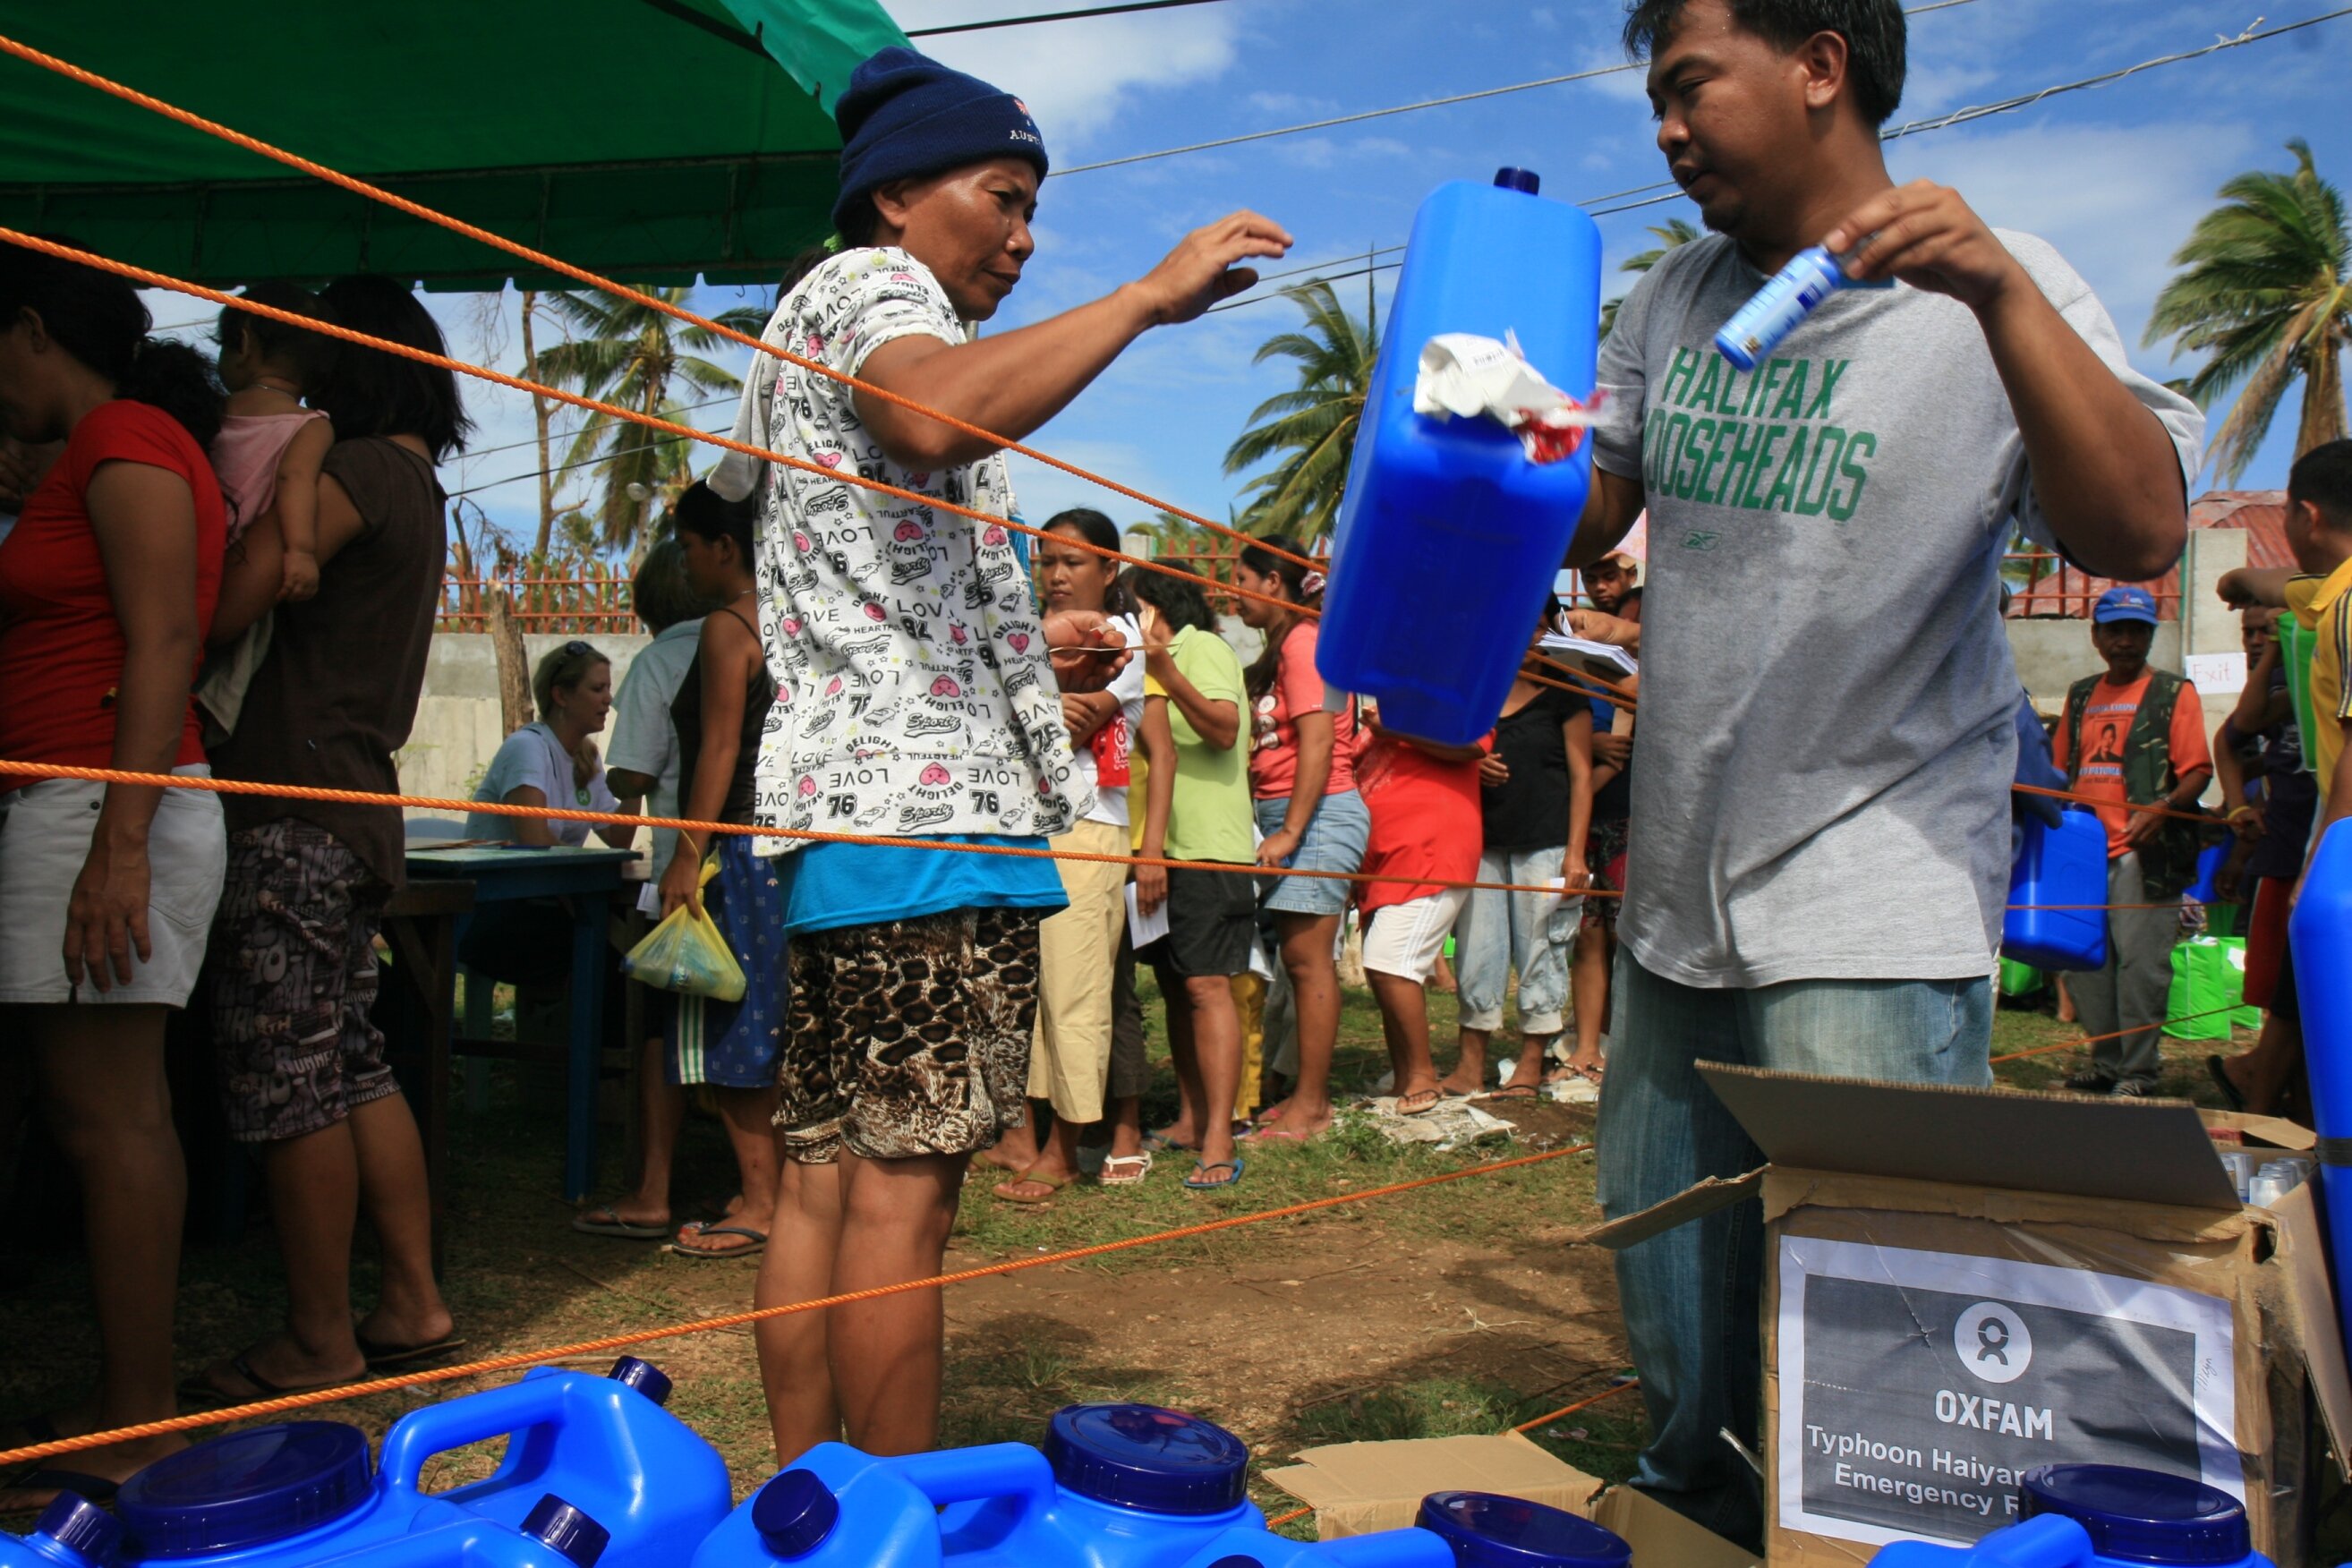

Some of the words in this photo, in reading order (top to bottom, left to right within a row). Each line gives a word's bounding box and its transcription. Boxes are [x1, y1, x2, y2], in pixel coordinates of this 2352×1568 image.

[1662, 346, 1850, 419] HALIFAX
[852, 446, 882, 462] LO
[1642, 407, 1877, 522] OOSEHEADS
[928, 546, 949, 562] LO
[897, 600, 942, 618] LOV
[993, 619, 1036, 639] DELIGHT
[850, 669, 899, 687] LOVE
[2193, 660, 2230, 683] Exit
[916, 692, 965, 712] ELIGHT
[967, 703, 992, 720] LO
[906, 712, 961, 730] Sporty
[846, 736, 899, 753] DELIGHT
[830, 768, 889, 788] LOVE
[967, 768, 1020, 787] LOVE
[754, 792, 788, 806] OVE
[908, 781, 964, 800] DELIGHT
[827, 793, 857, 820] 76
[969, 788, 1001, 815] 76
[899, 803, 954, 822] Sporty
[1935, 1389, 2053, 1441] OXFAM
[1806, 1424, 1922, 1468] Typhoon
[1835, 1461, 1993, 1515] Emergency
